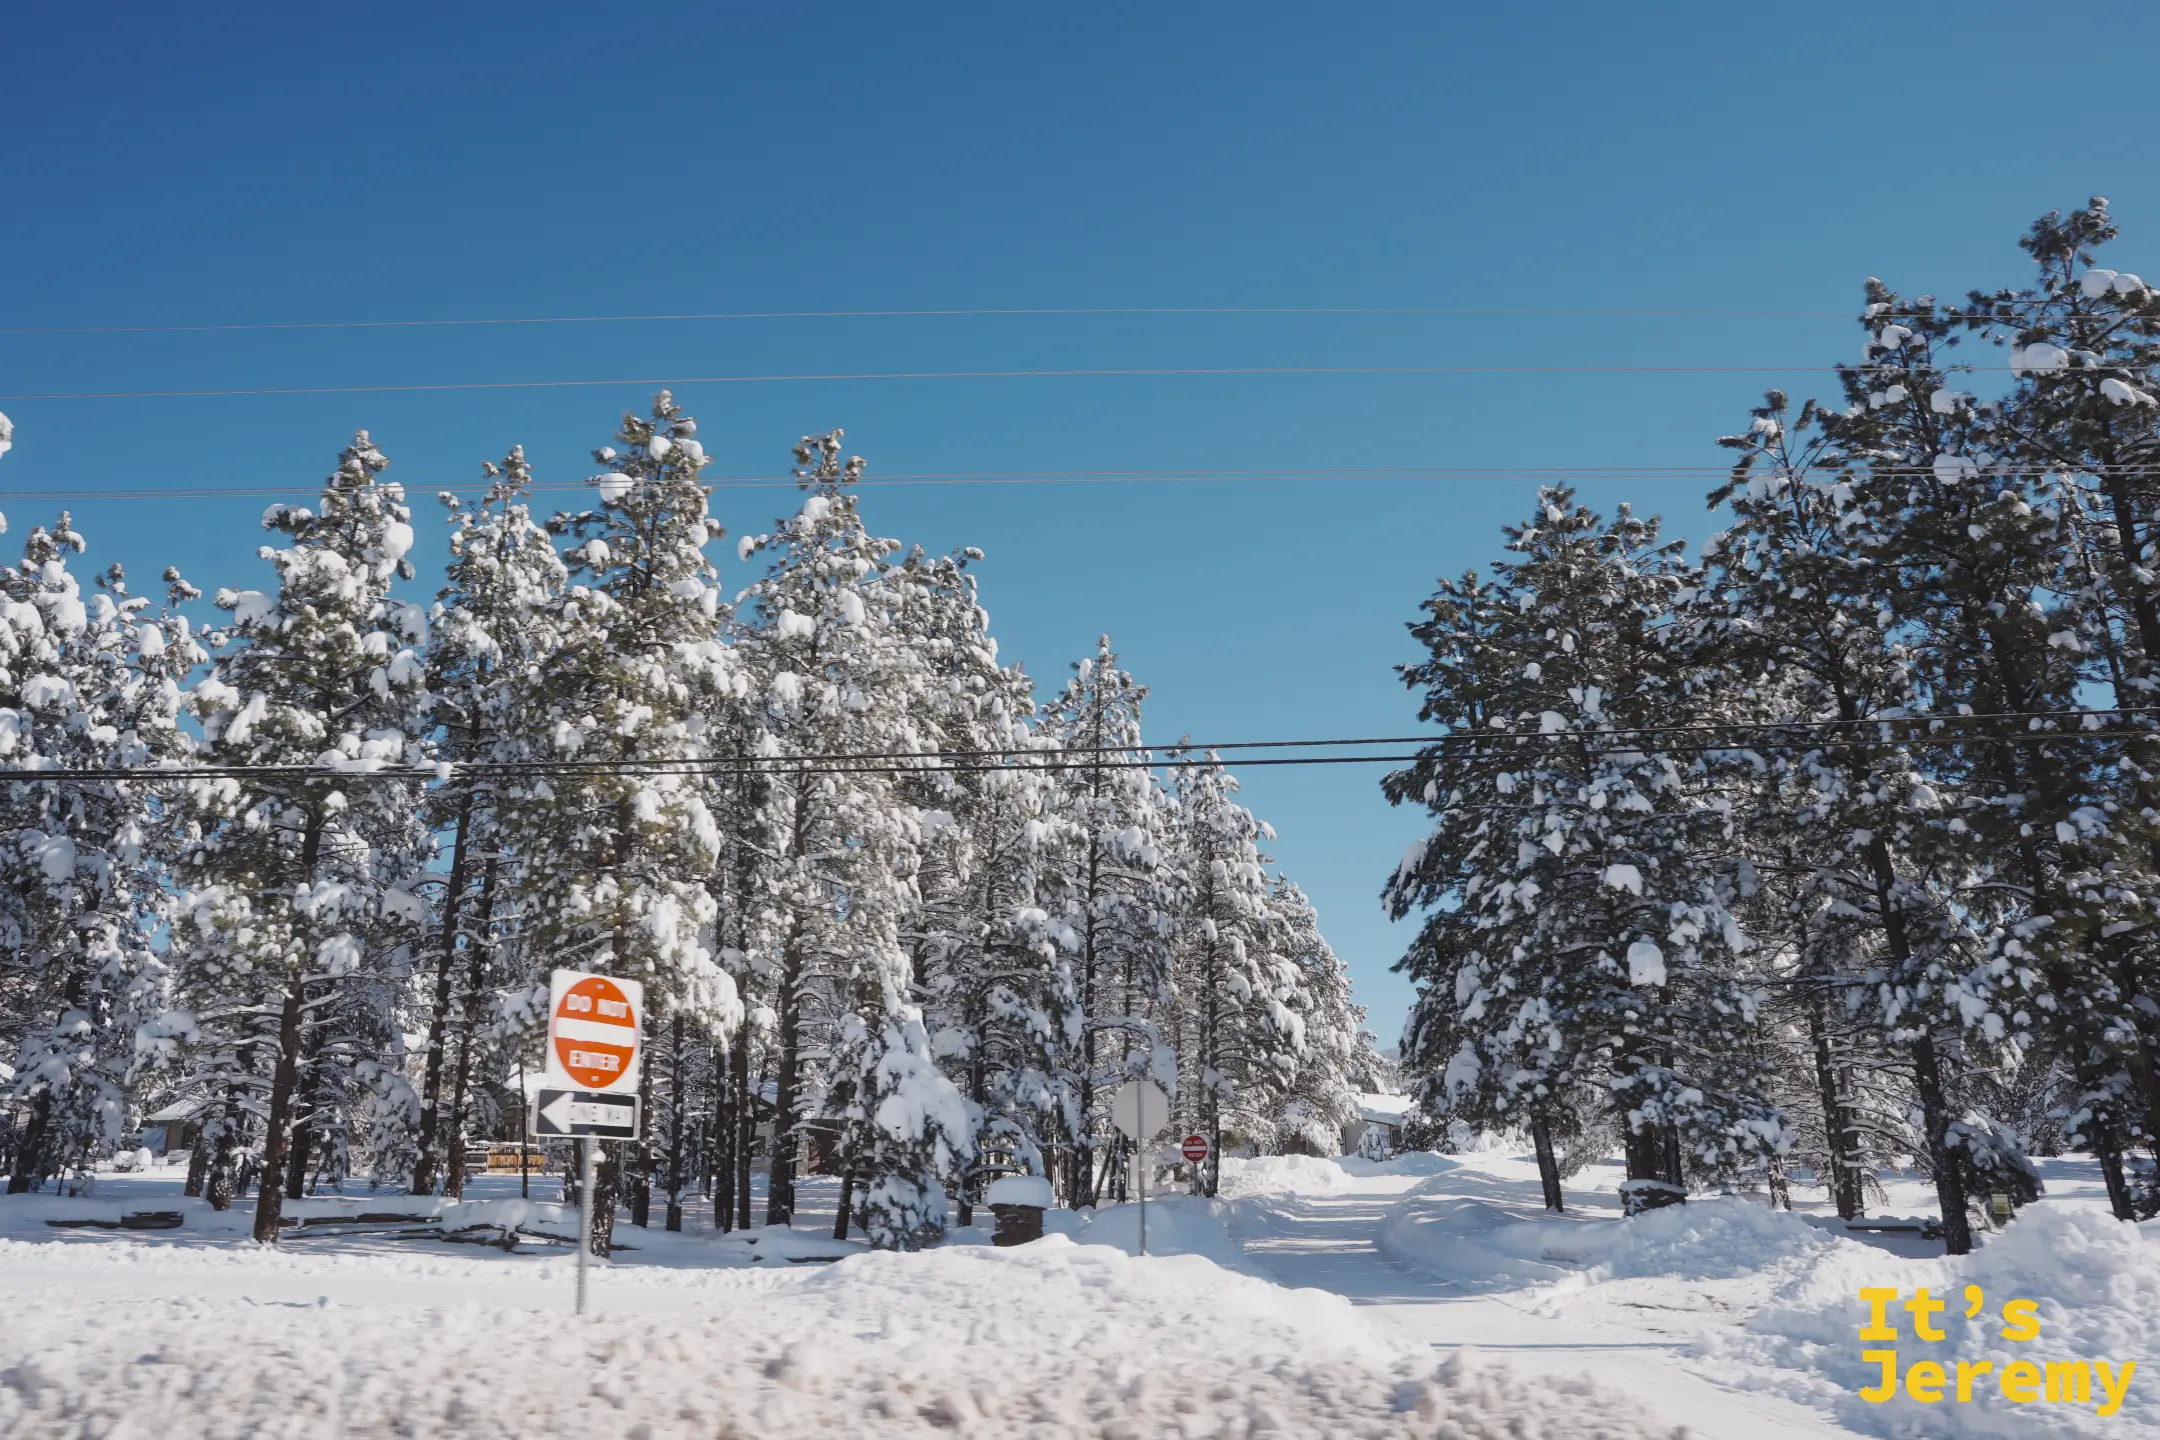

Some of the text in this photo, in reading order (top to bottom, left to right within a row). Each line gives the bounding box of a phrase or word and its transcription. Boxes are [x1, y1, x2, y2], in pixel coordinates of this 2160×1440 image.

[566, 993, 628, 1018] DO NOT
[568, 1049, 620, 1072] ENTER
